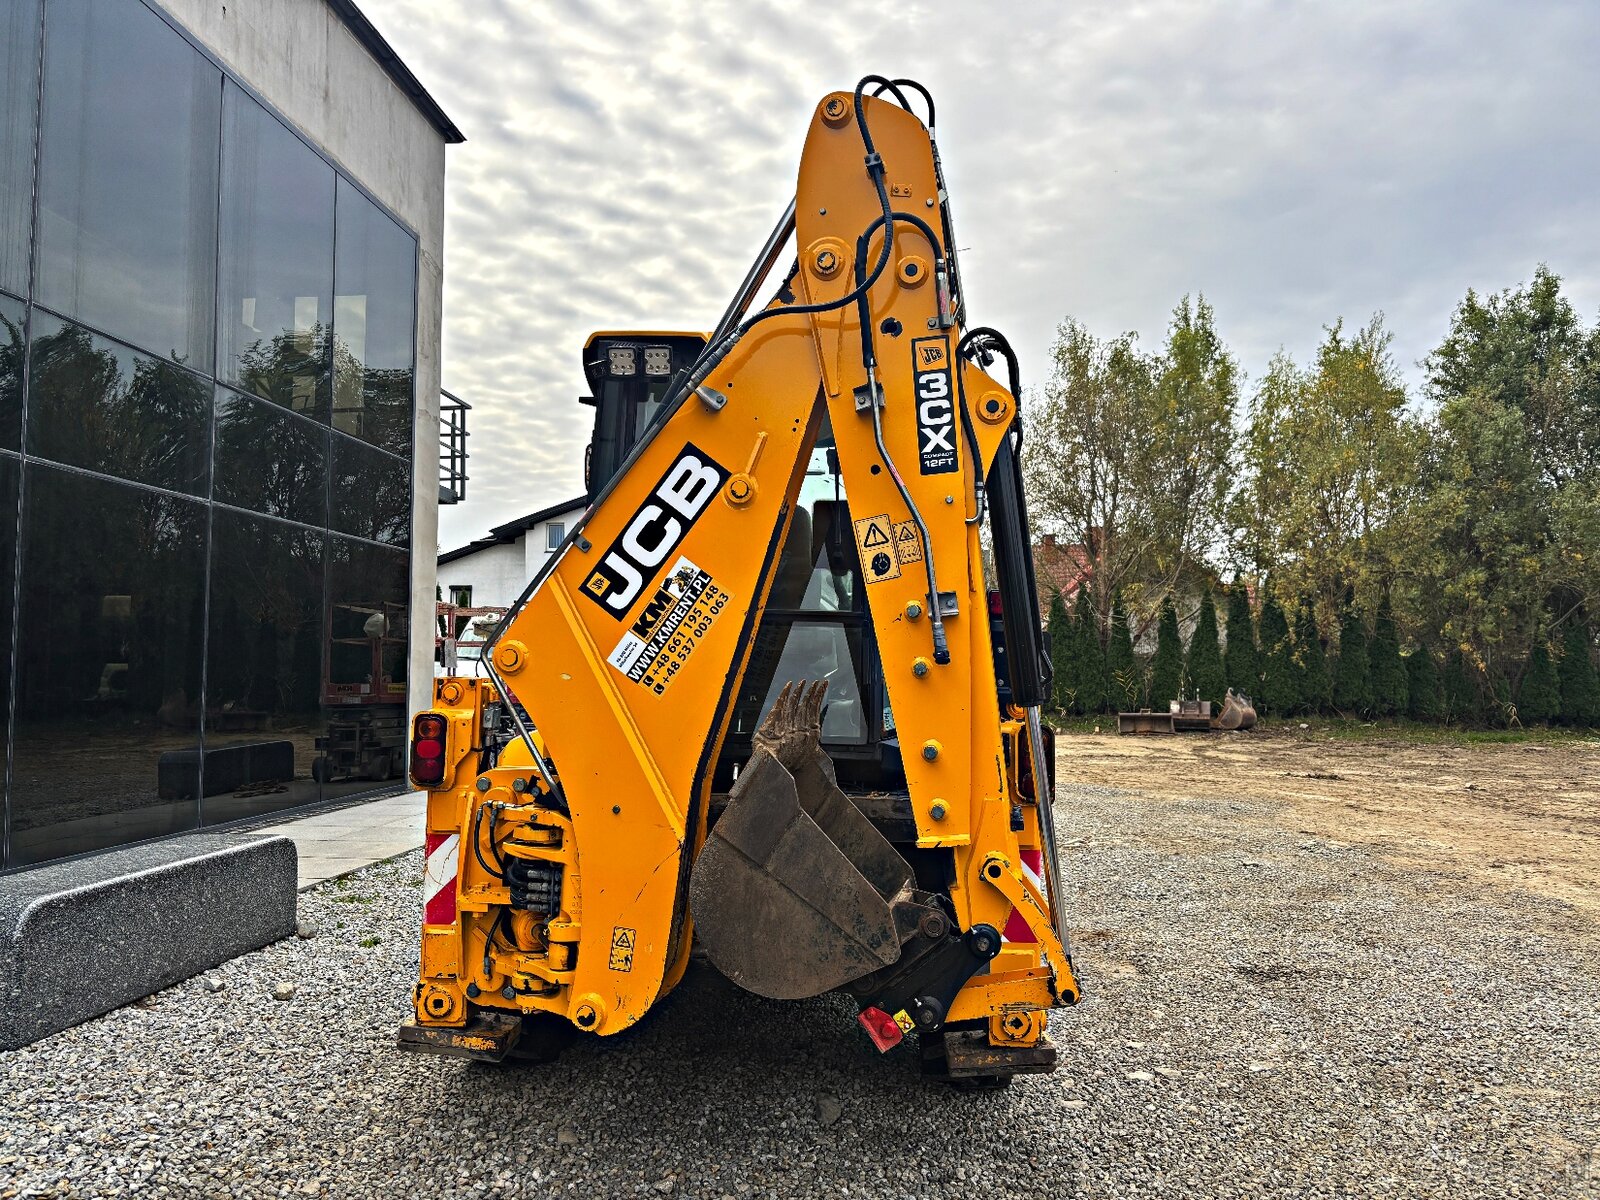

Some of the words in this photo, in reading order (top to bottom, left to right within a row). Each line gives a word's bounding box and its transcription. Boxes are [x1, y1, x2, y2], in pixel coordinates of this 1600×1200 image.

[919, 346, 944, 365] JCB
[919, 373, 955, 453] 3CX
[924, 458, 953, 467] 12FT
[604, 455, 721, 610] JCB
[627, 577, 710, 679] WWW.KMRENT.PL
[631, 589, 672, 638] KM
[653, 654, 670, 675] +48
[666, 631, 685, 653] 661
[682, 607, 702, 629] 195
[699, 584, 718, 607] 148
[663, 662, 680, 684] +48
[677, 637, 695, 661] 537
[693, 614, 712, 638] 003
[709, 592, 729, 615] 063
